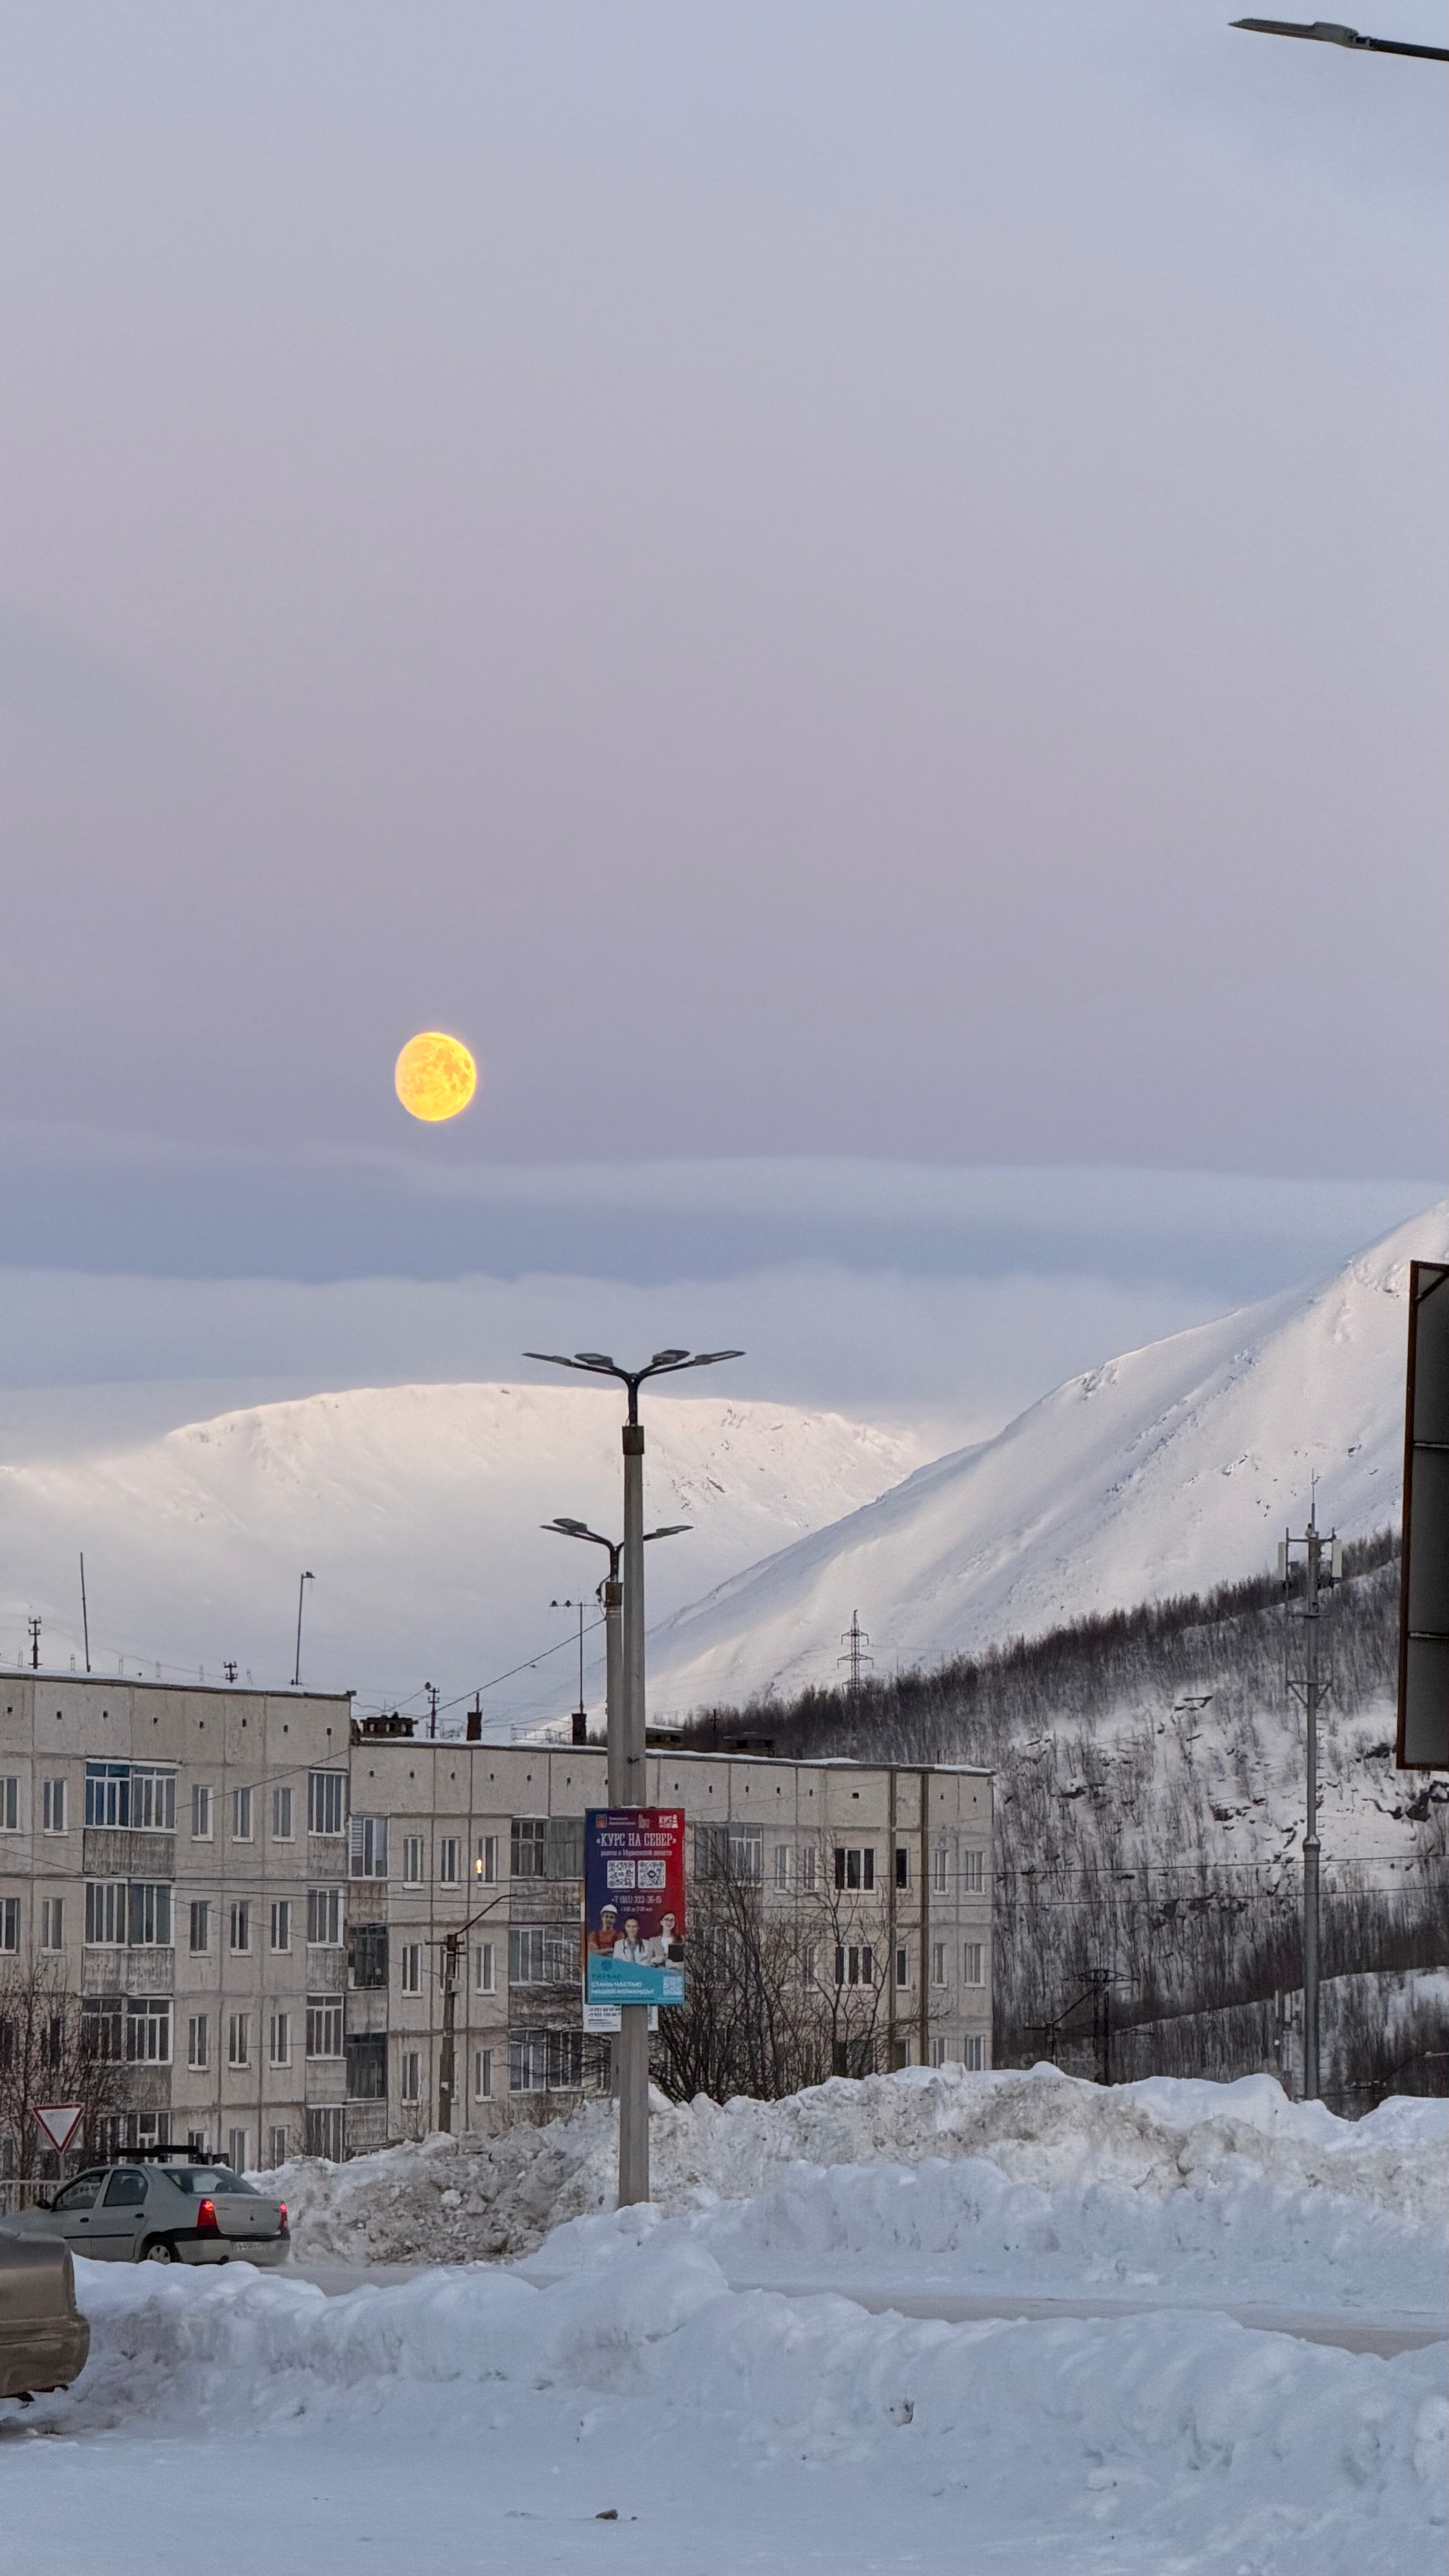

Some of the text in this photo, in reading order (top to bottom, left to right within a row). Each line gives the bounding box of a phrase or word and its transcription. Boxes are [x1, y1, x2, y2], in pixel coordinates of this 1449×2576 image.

[596, 1833, 676, 1846] «КУРС НА СЕВЕР»
